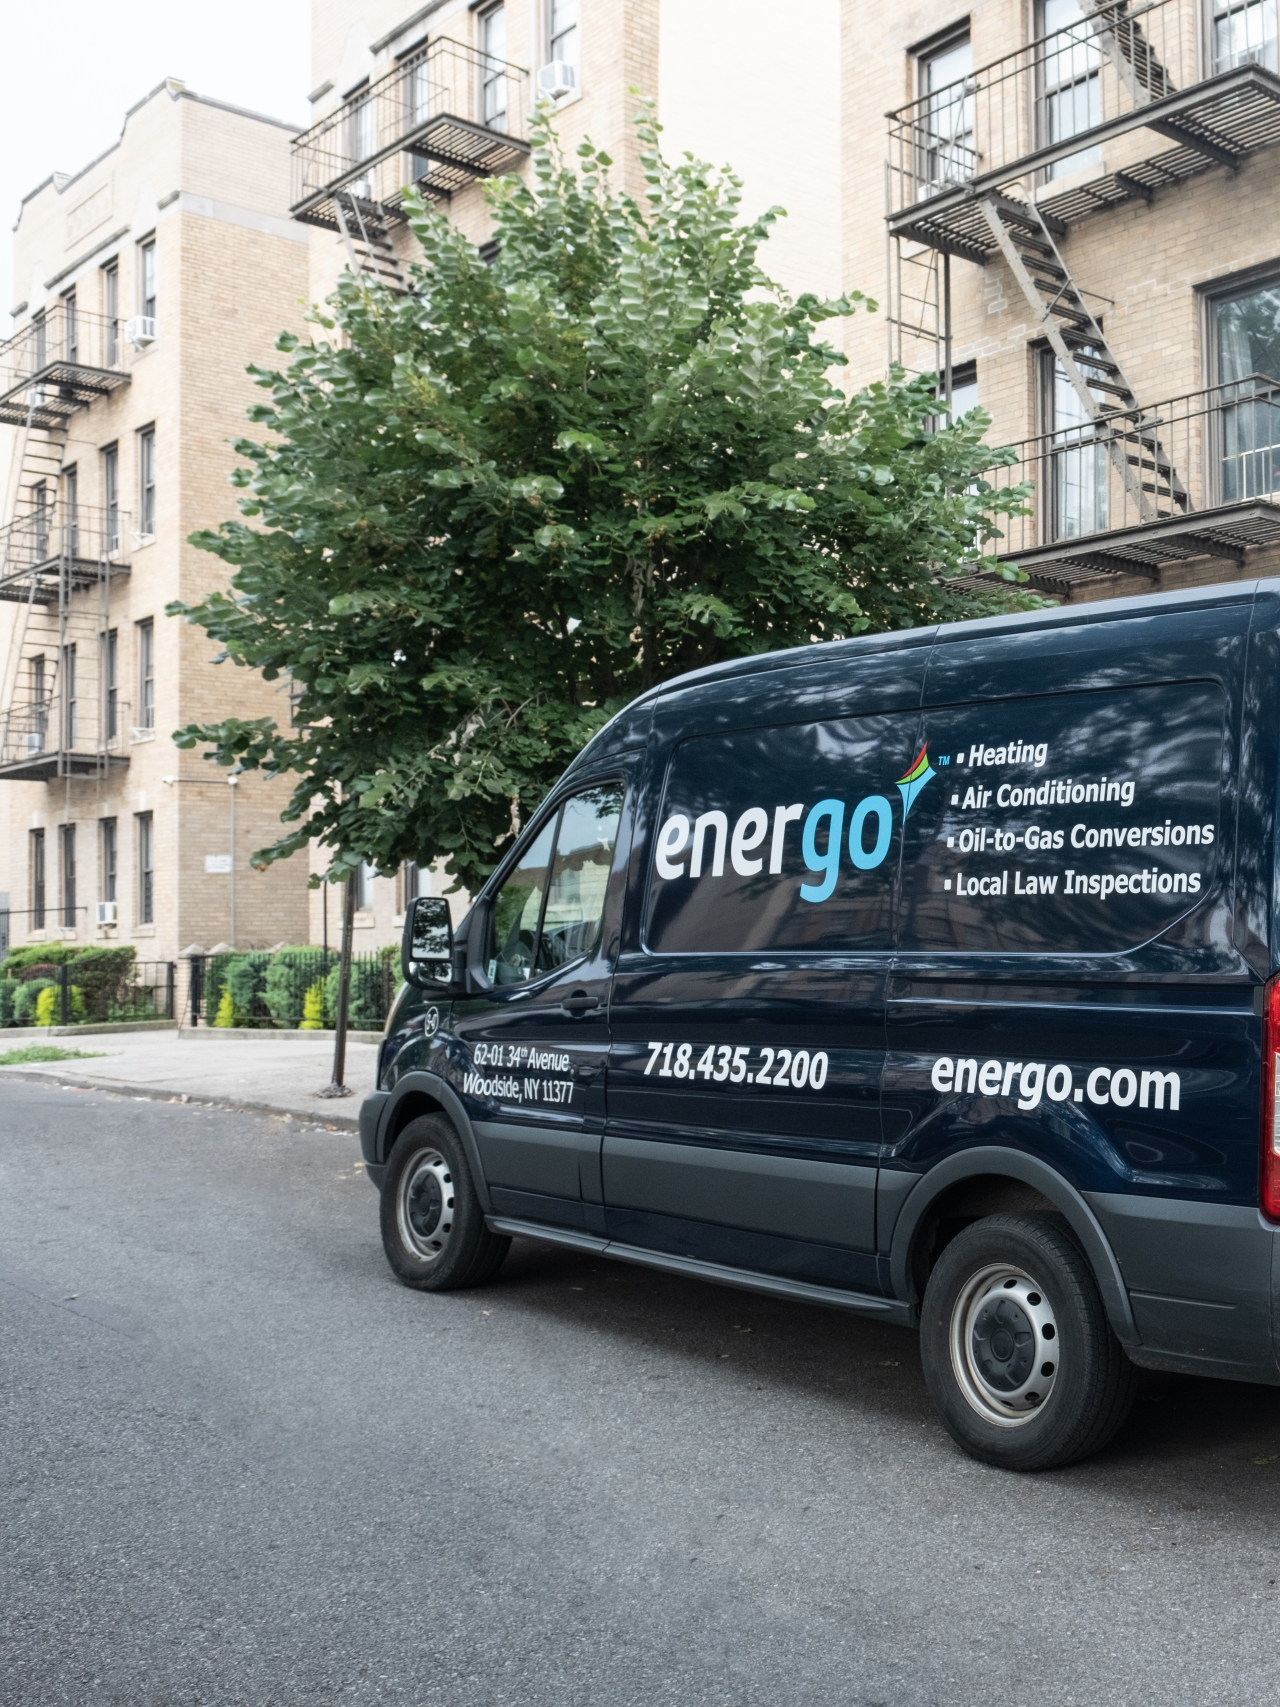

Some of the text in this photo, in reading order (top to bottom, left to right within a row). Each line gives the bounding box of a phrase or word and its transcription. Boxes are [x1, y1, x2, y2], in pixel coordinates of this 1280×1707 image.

[968, 740, 1048, 768] Heating
[962, 775, 1135, 809] Air Conditioning
[655, 795, 893, 903] energo
[958, 820, 1215, 853] Oil-to-Gas Conversions
[956, 868, 1201, 899] Local Law Inspections
[473, 1043, 504, 1066] 62-01
[527, 1047, 570, 1072] Avenue
[643, 1041, 829, 1090] 718.435.2200
[463, 1072, 574, 1104] Woodside, NY 11377
[931, 1056, 1181, 1111] energo.com
